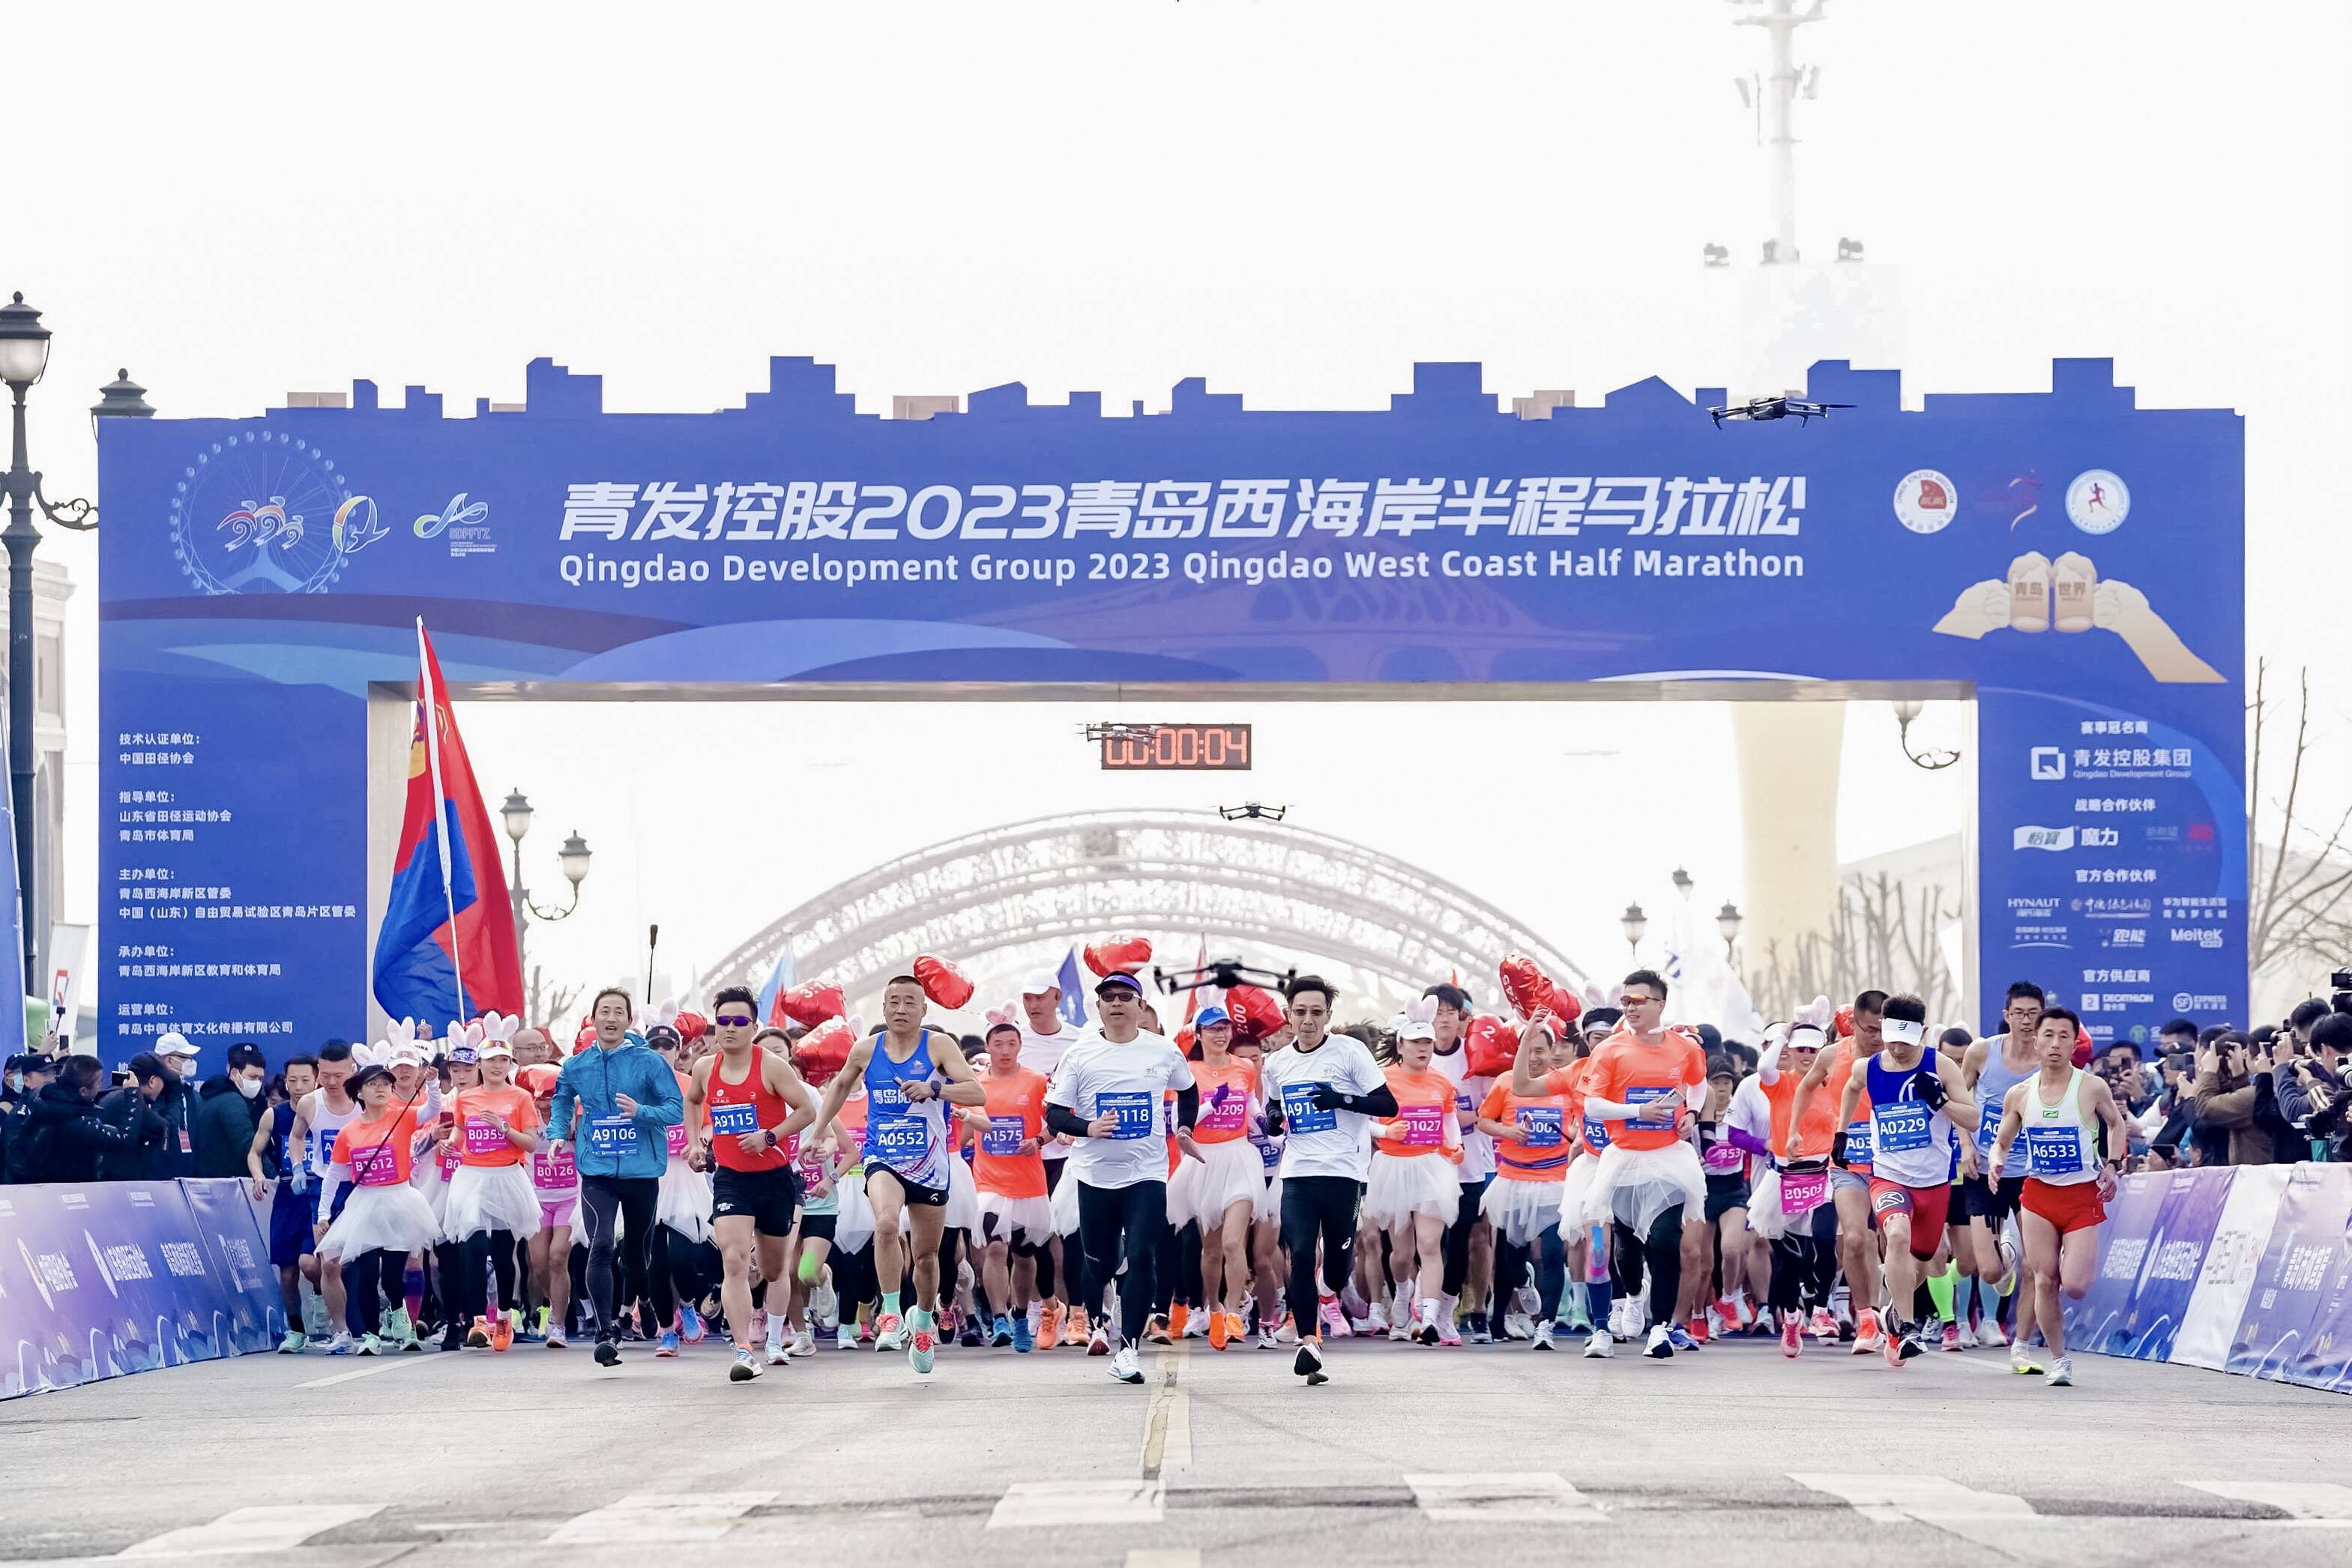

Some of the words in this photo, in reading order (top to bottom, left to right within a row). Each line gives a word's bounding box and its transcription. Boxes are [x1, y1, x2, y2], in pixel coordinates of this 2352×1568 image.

[558, 476, 1806, 540] 青发控股2023青岛西海岸半程马拉松
[560, 552, 710, 588] Qingdao
[723, 552, 959, 588] Development
[971, 554, 1076, 587] Group
[1088, 552, 1170, 579] 2023
[1183, 550, 1333, 585] Qingdao
[1344, 551, 1429, 578] West
[1441, 550, 1537, 577] Coast
[1550, 548, 1623, 576] Half
[1634, 548, 1803, 577] Marathon
[2080, 720, 2149, 735] 赛事冠名商
[119, 751, 195, 765] 中国田径协会
[2073, 748, 2192, 768] 青发控股集团
[2073, 770, 2108, 779] Qingdao
[2110, 769, 2164, 778] Development
[2165, 769, 2191, 779] Group
[2075, 798, 2156, 812] 战略合作伙伴
[119, 809, 232, 823] 山东省田径运动协会
[119, 829, 195, 842] 青岛市体育局
[2081, 827, 2120, 846] 魔力
[2075, 869, 2156, 883] 官方合作伙伴
[119, 887, 232, 900] 青岛西海岸新区管委
[2007, 898, 2060, 908] HYNAUT
[119, 905, 357, 920] 中国（山东）自由贸易试验区青岛片区管委
[118, 963, 282, 977] 青岛西海岸新区教育和体育局
[2083, 969, 2150, 983] 官方供应商
[2102, 993, 2154, 1003] DECATHLON
[118, 1022, 294, 1036] 青岛中德体育文化传播有限公司
[1100, 1109, 1149, 1123] A118
[1210, 1103, 1244, 1116] 0209
[1288, 1102, 1332, 1117] A91
[714, 1112, 754, 1127] A9115
[1584, 1125, 1608, 1139] A51
[1880, 1118, 1926, 1136] A0229
[591, 1127, 636, 1142] A9106
[878, 1131, 925, 1146] A0552
[983, 1130, 1023, 1142] A1575
[1846, 1137, 1872, 1150] A03
[2032, 1145, 2077, 1158] A6533
[537, 1165, 574, 1177] B0126
[1784, 1183, 1823, 1200] B0503
